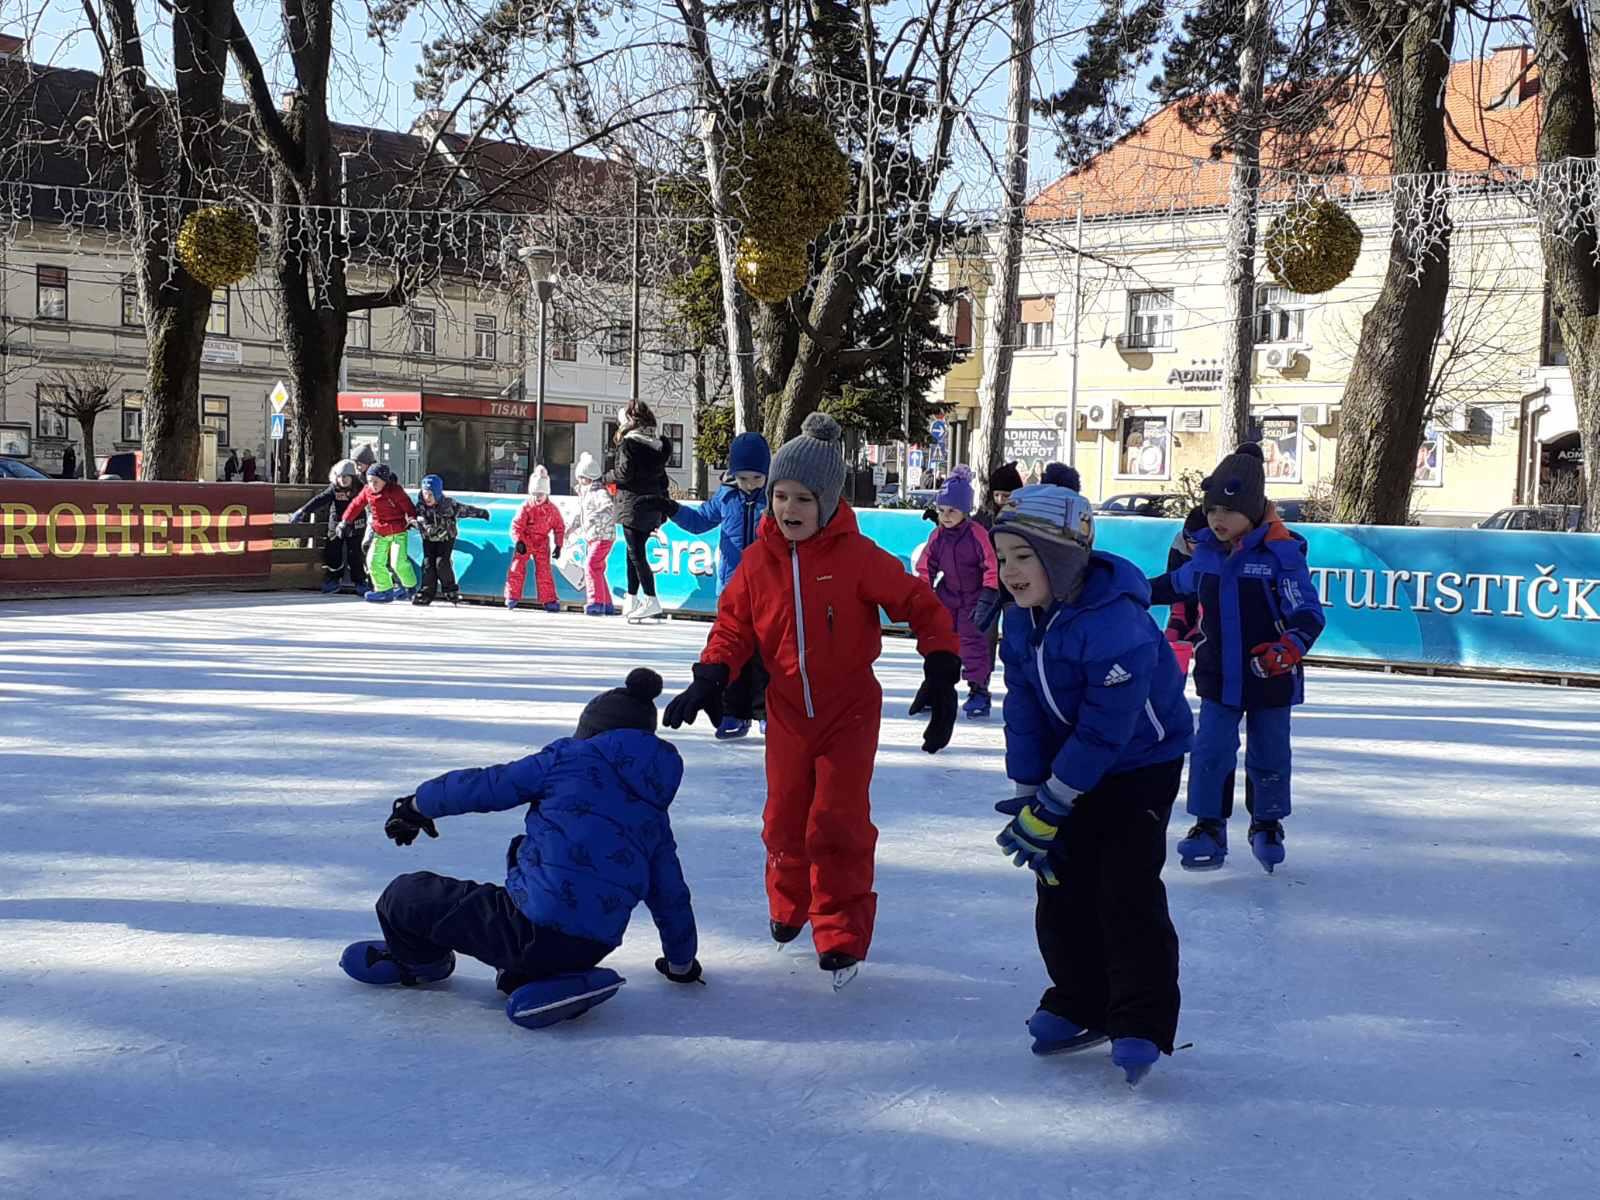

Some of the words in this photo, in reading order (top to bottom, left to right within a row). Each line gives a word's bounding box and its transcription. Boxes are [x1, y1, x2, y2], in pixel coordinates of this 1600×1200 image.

[361, 398, 384, 408] TISAK
[489, 402, 528, 416] TISAK
[1004, 430, 1055, 441] ADMIRAL
[0, 502, 248, 558] ROHERC
